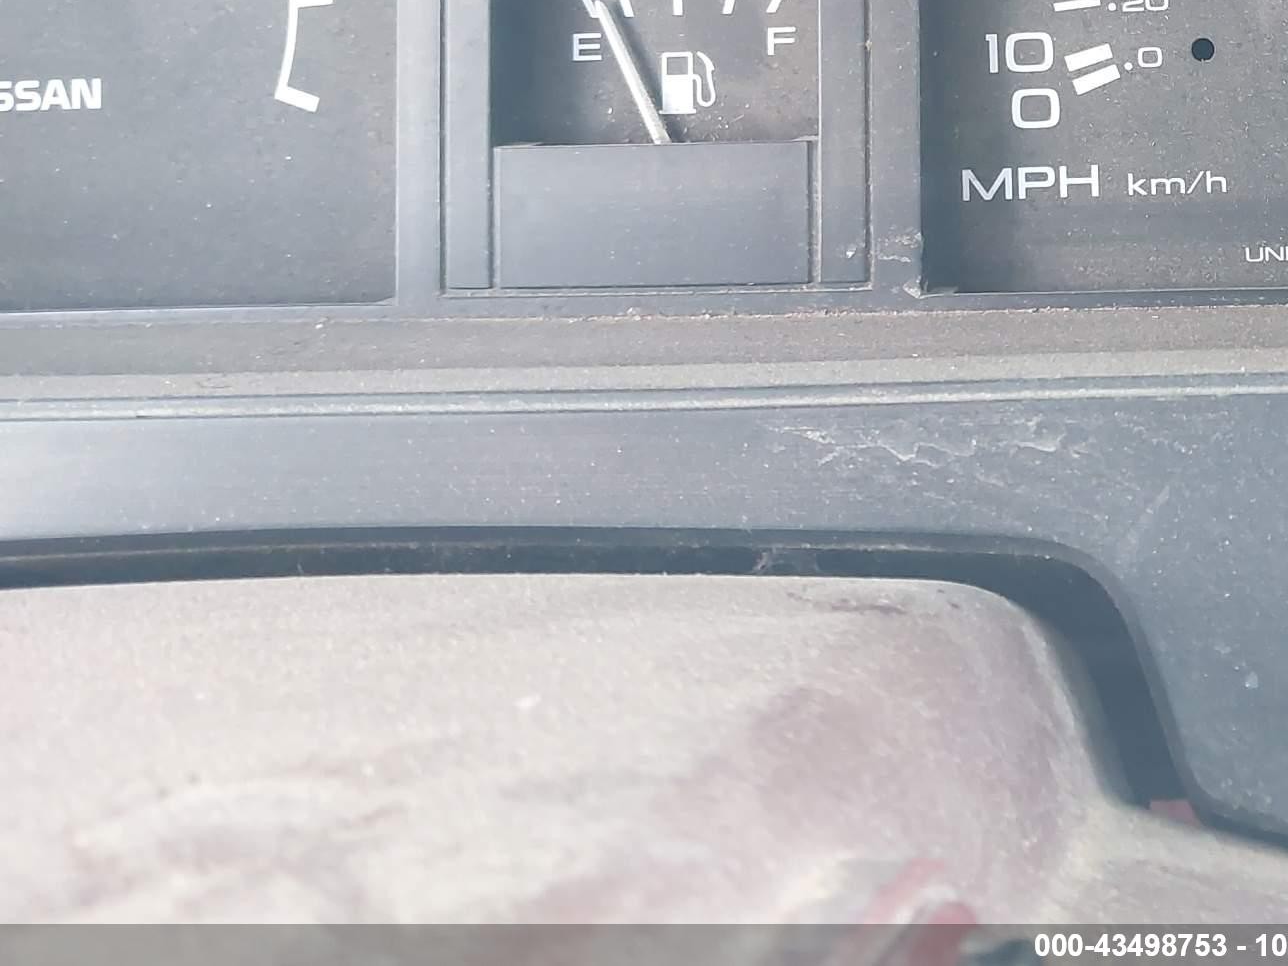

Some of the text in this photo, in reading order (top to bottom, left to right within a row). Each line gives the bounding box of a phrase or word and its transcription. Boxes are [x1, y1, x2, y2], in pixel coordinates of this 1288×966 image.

[573, 33, 602, 60] E
[767, 27, 796, 55] F
[986, 32, 1053, 73] 10
[1138, 47, 1162, 67] 0
[1012, 89, 1060, 128] 0
[963, 165, 1226, 200] MPH km/h
